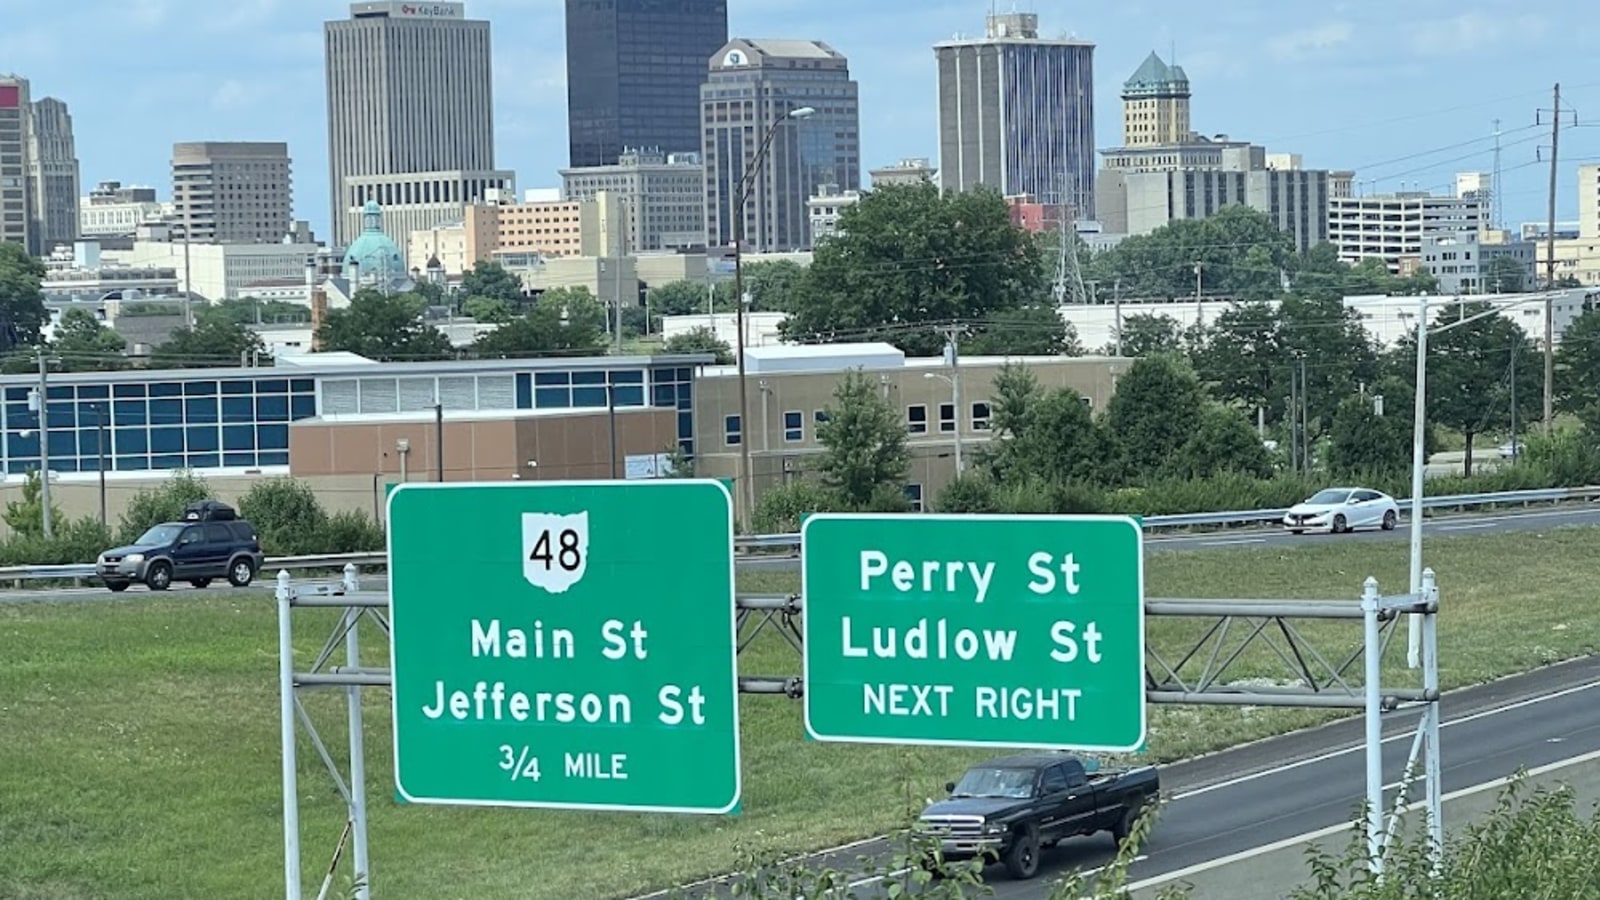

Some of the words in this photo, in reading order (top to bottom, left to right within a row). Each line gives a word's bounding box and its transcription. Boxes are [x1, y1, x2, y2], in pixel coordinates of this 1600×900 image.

[418, 6, 455, 17] KeyBank
[529, 528, 581, 572] 48
[860, 550, 995, 603] Perry
[1028, 551, 1080, 594] St
[471, 619, 574, 658] Main
[602, 619, 647, 659] St
[842, 616, 1017, 661] Ludlow
[1050, 620, 1102, 663] St
[422, 681, 631, 723] Jefferson
[658, 685, 705, 725] St
[864, 683, 954, 716] NEXT
[976, 686, 1082, 721] RIGHT
[499, 744, 541, 781] 3/4
[565, 753, 628, 779] MILE
